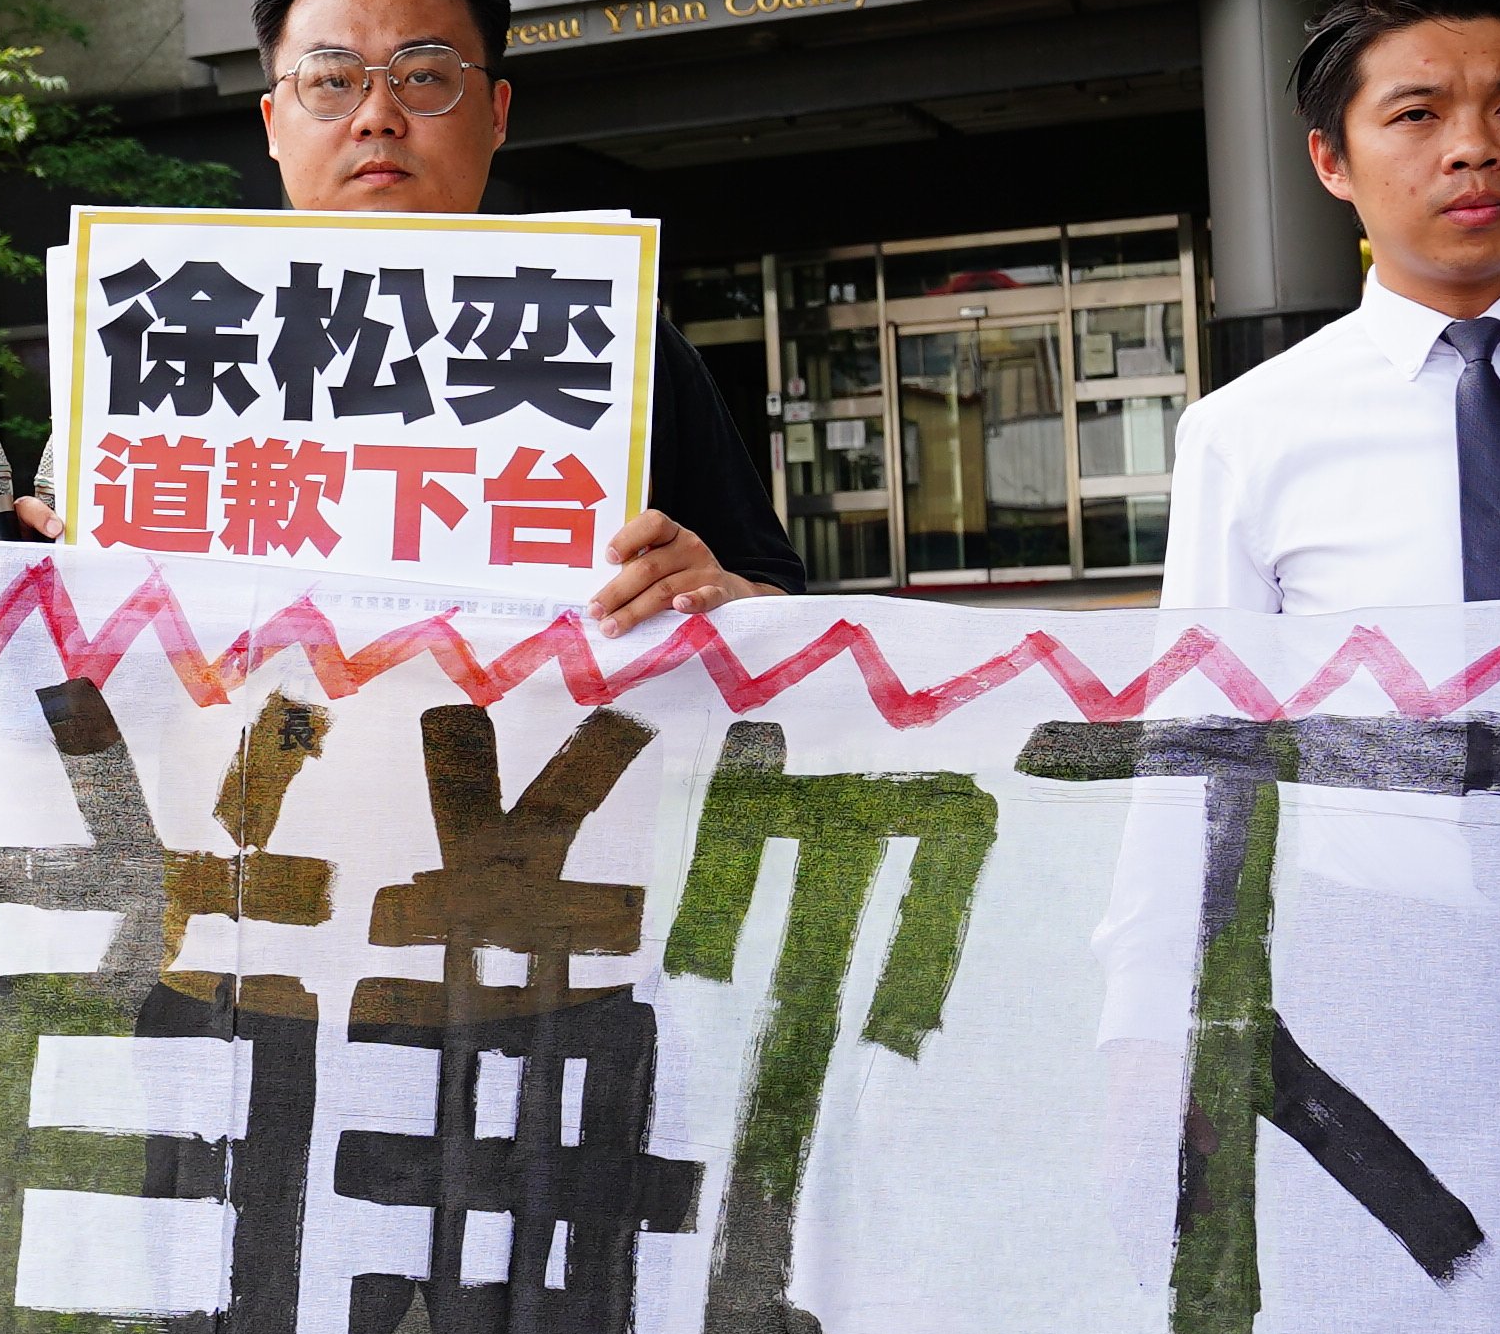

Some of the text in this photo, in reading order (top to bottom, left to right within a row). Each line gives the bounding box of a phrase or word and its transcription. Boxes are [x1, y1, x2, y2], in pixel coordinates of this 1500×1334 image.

[505, 17, 583, 48] reau
[98, 258, 616, 431] 徐松奕
[91, 432, 607, 569] 道歉下台
